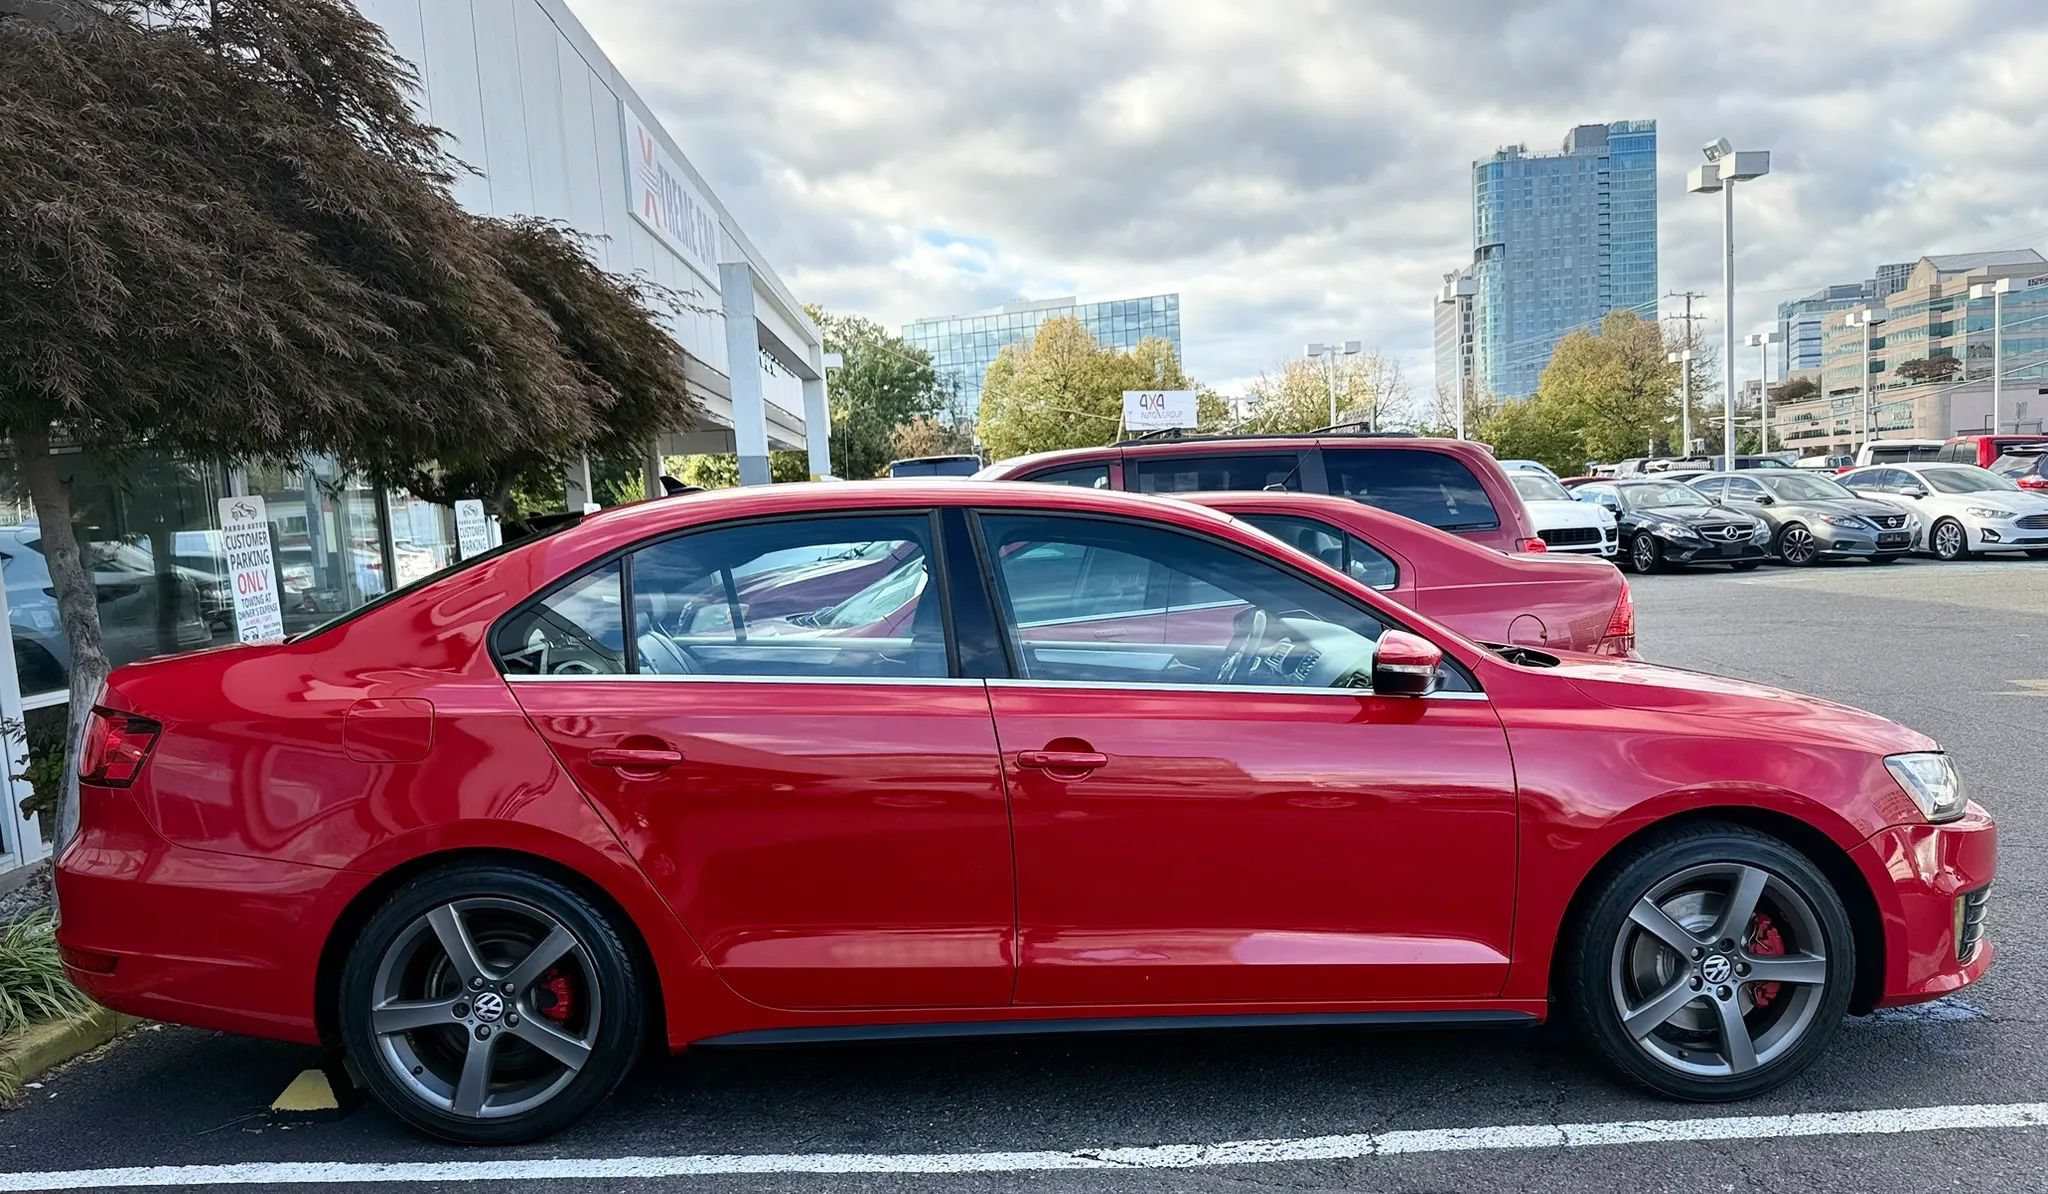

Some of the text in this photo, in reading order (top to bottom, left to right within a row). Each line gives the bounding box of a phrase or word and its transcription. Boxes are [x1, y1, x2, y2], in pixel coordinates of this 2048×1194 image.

[225, 531, 269, 551] CUSTOMER
[460, 526, 484, 538] CUSTOMER
[230, 549, 270, 571] PARKING
[237, 568, 268, 595] ONLY
[241, 592, 272, 609] TOWING AT
